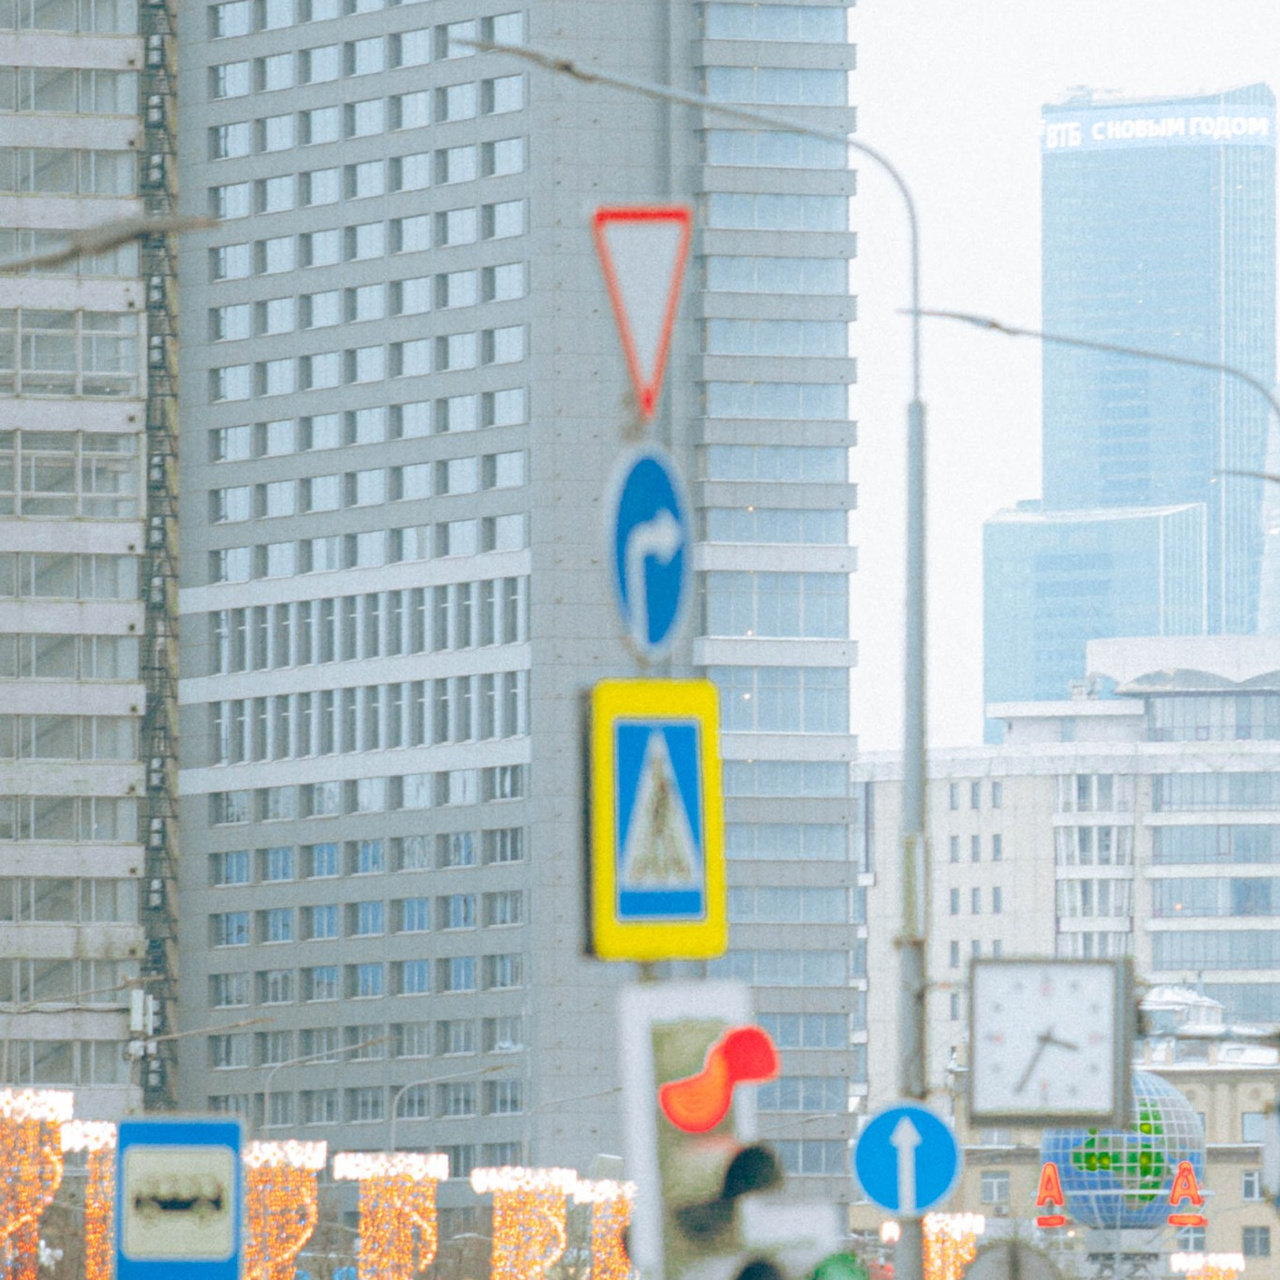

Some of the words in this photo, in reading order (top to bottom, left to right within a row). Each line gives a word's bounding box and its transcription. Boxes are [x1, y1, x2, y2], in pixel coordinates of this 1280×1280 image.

[1046, 122, 1082, 148] ВТБ
[1091, 122, 1106, 140] С
[1107, 117, 1186, 138] НОВЫМ
[1188, 116, 1269, 141] ГОДОМ
